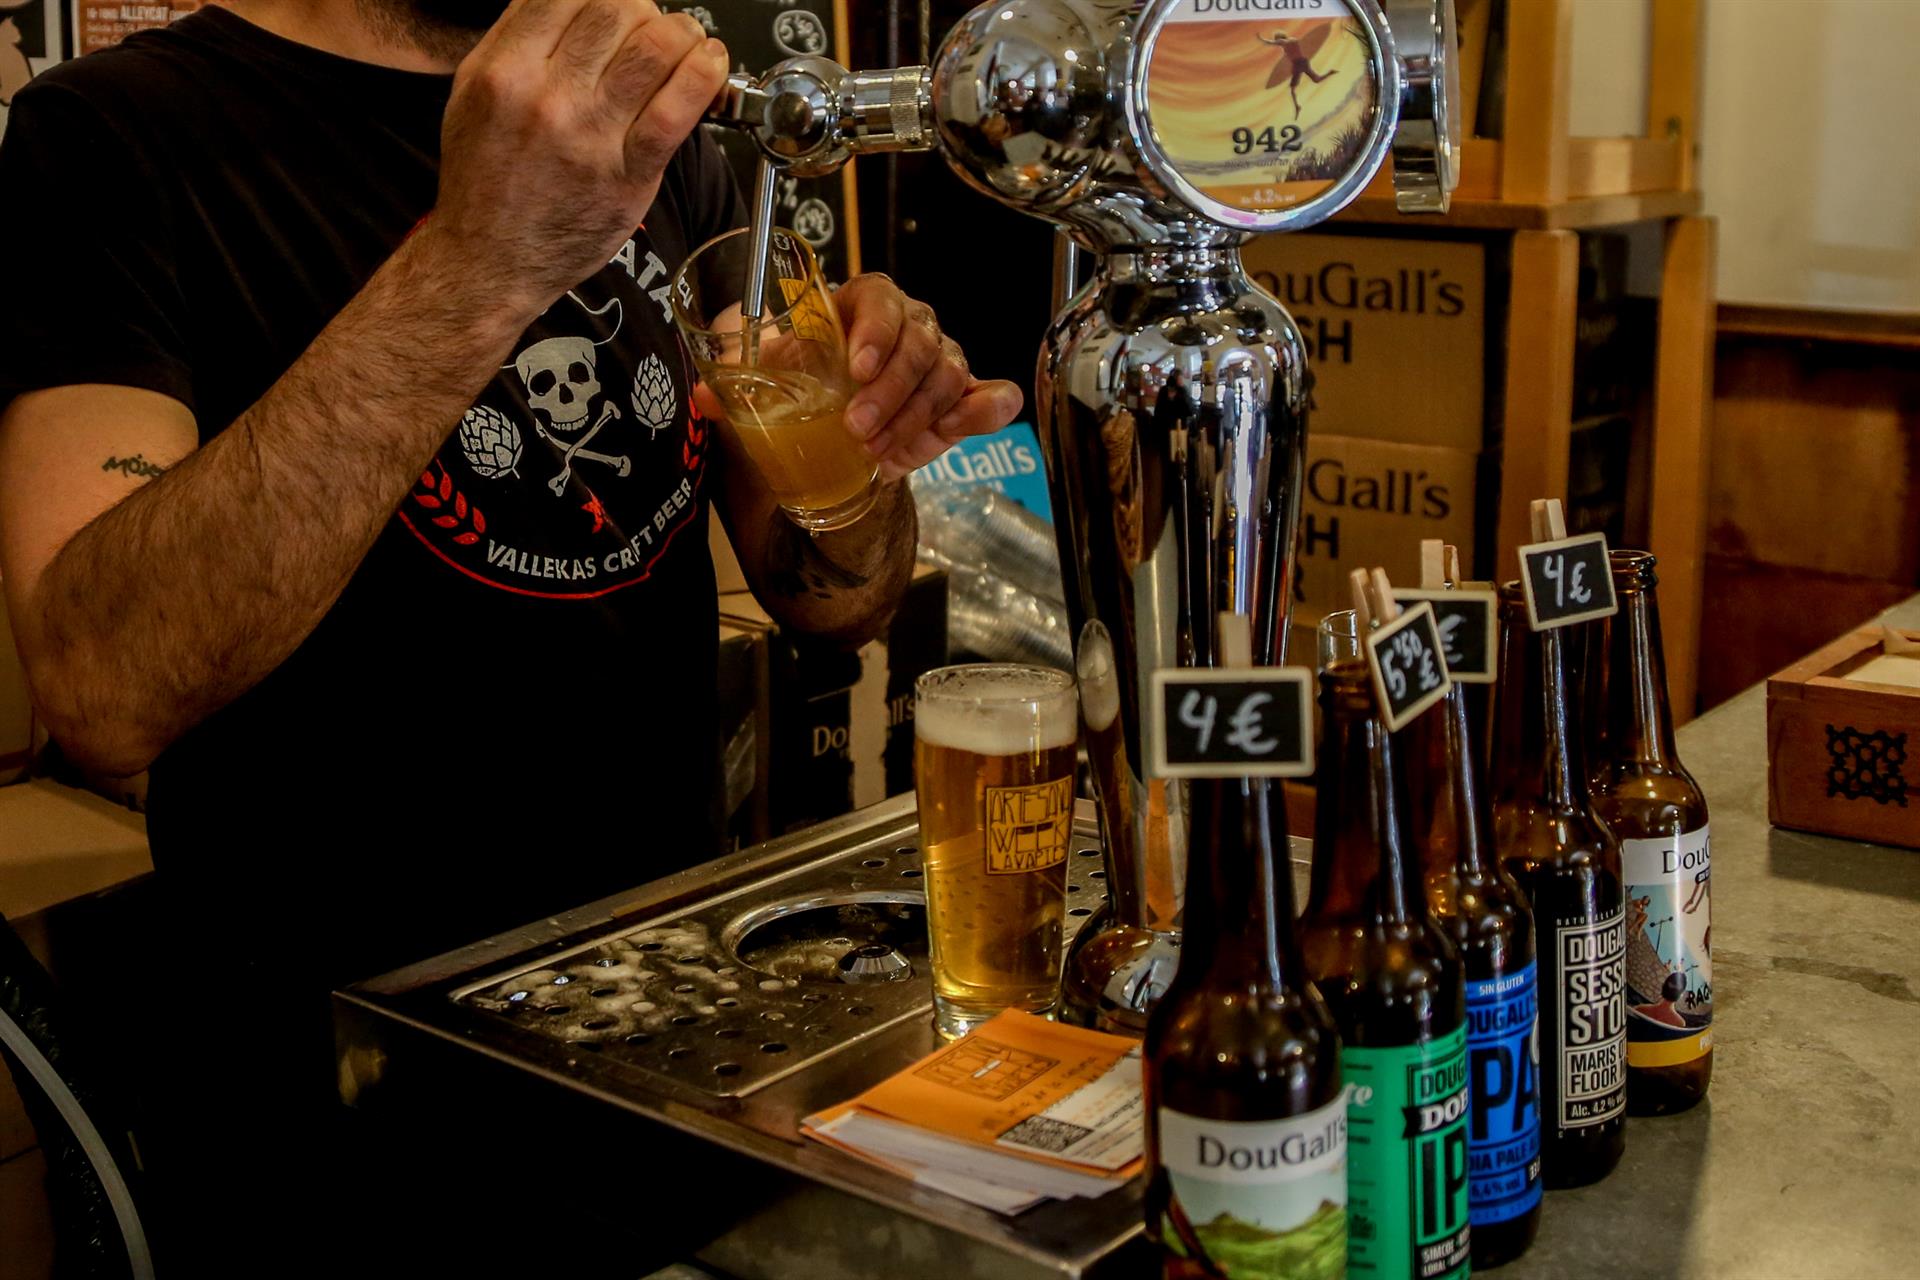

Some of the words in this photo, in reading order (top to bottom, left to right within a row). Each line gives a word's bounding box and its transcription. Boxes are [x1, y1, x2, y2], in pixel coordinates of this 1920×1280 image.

[1231, 124, 1304, 154] 942
[485, 539, 598, 581] VALLEKAS
[652, 476, 692, 533] BEER
[1541, 554, 1567, 607] 4
[1178, 690, 1217, 754] 4
[1226, 691, 1279, 755] €
[1478, 983, 1495, 996] SIN
[1570, 1044, 1617, 1073] MARIS
[1571, 1064, 1618, 1094] FLOOR
[1571, 1103, 1591, 1118] Alc.
